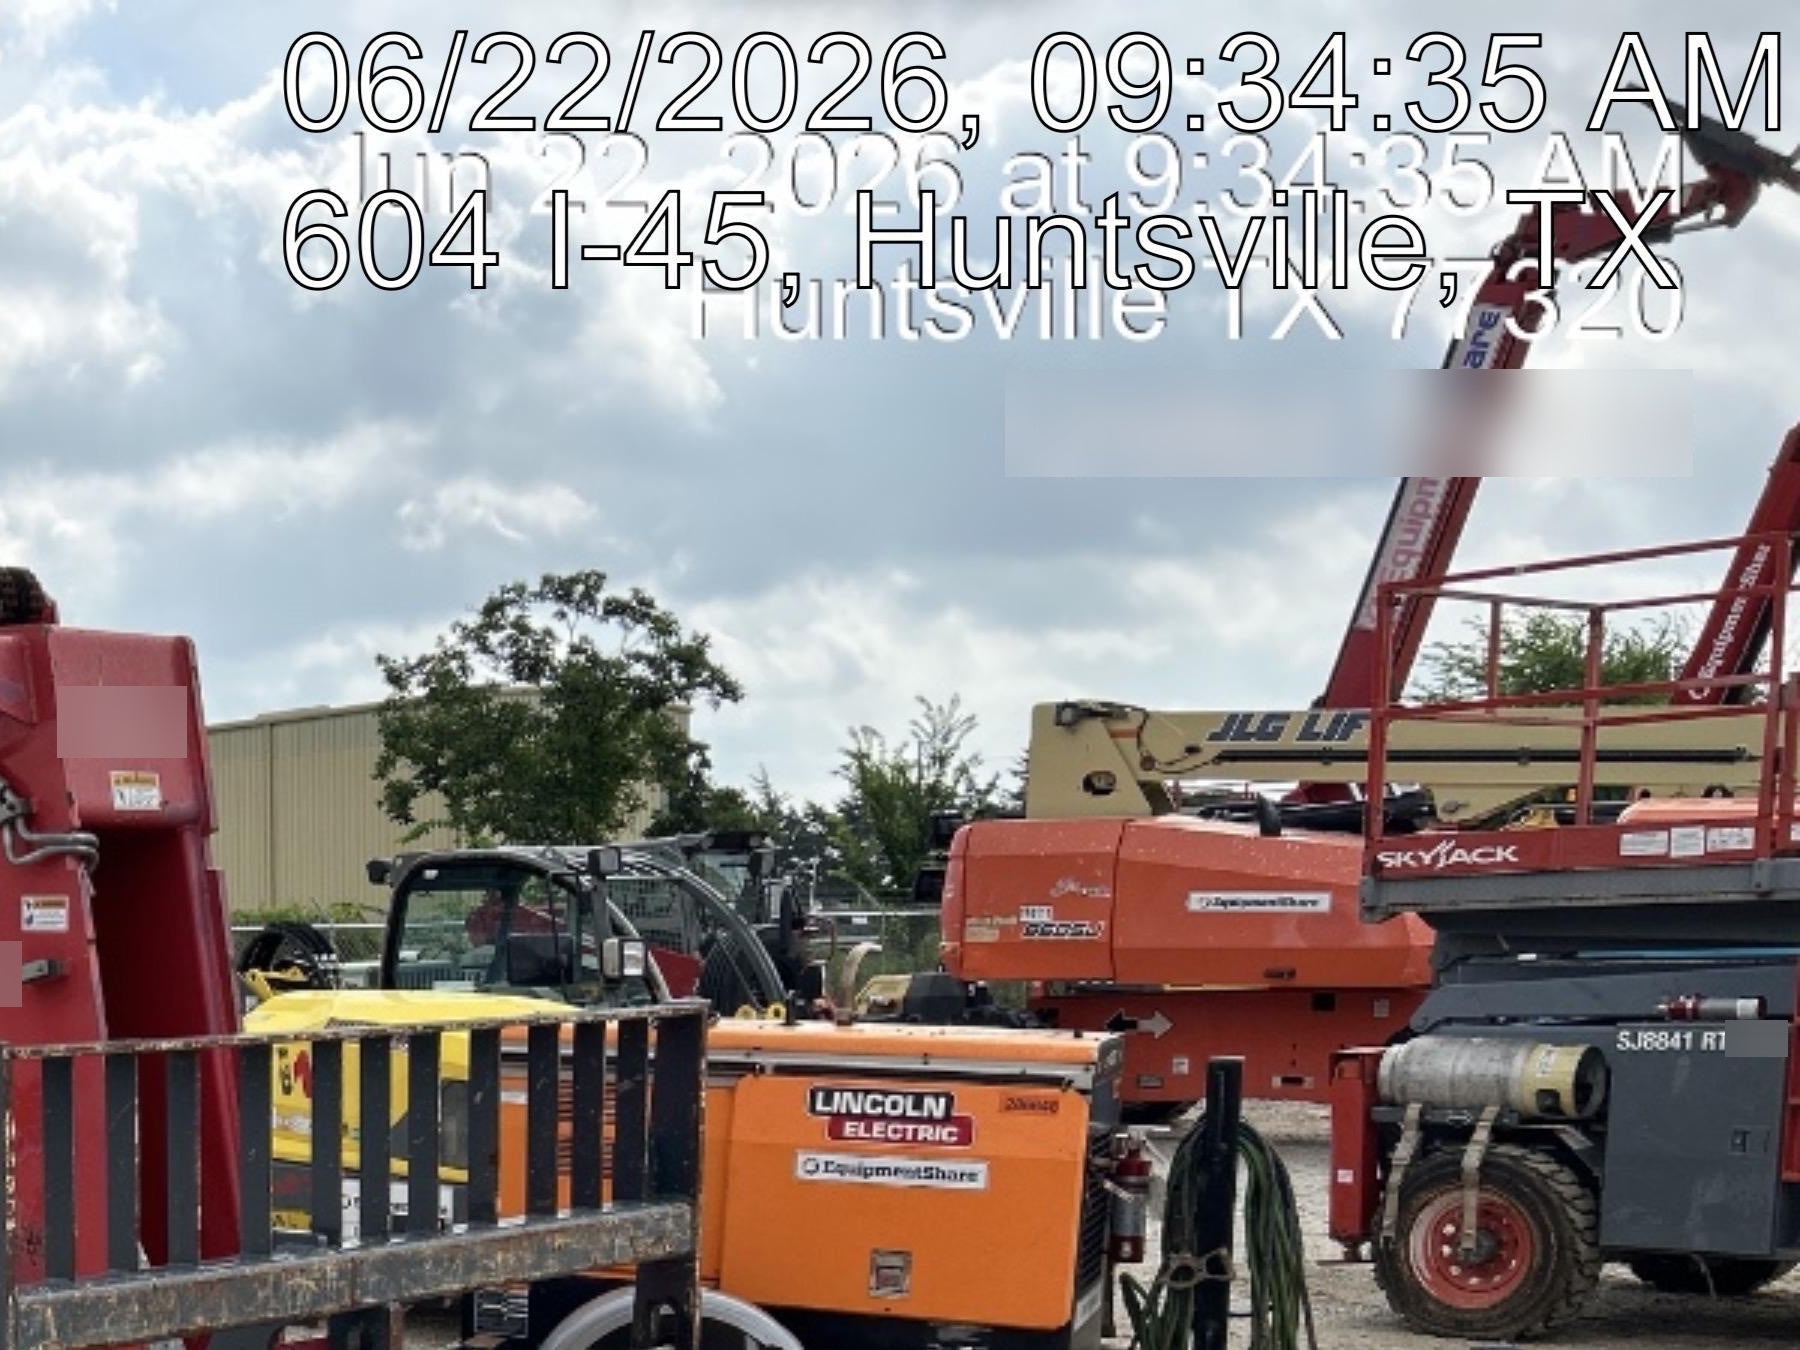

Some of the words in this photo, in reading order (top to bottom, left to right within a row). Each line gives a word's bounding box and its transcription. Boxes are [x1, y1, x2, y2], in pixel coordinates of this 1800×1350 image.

[1205, 712, 1291, 742] JLG
[1376, 839, 1520, 870] SKYJACK
[1615, 1030, 1693, 1051] SJ8841
[814, 1090, 947, 1118] LINCOLN
[842, 1120, 959, 1144] ELECTRIC
